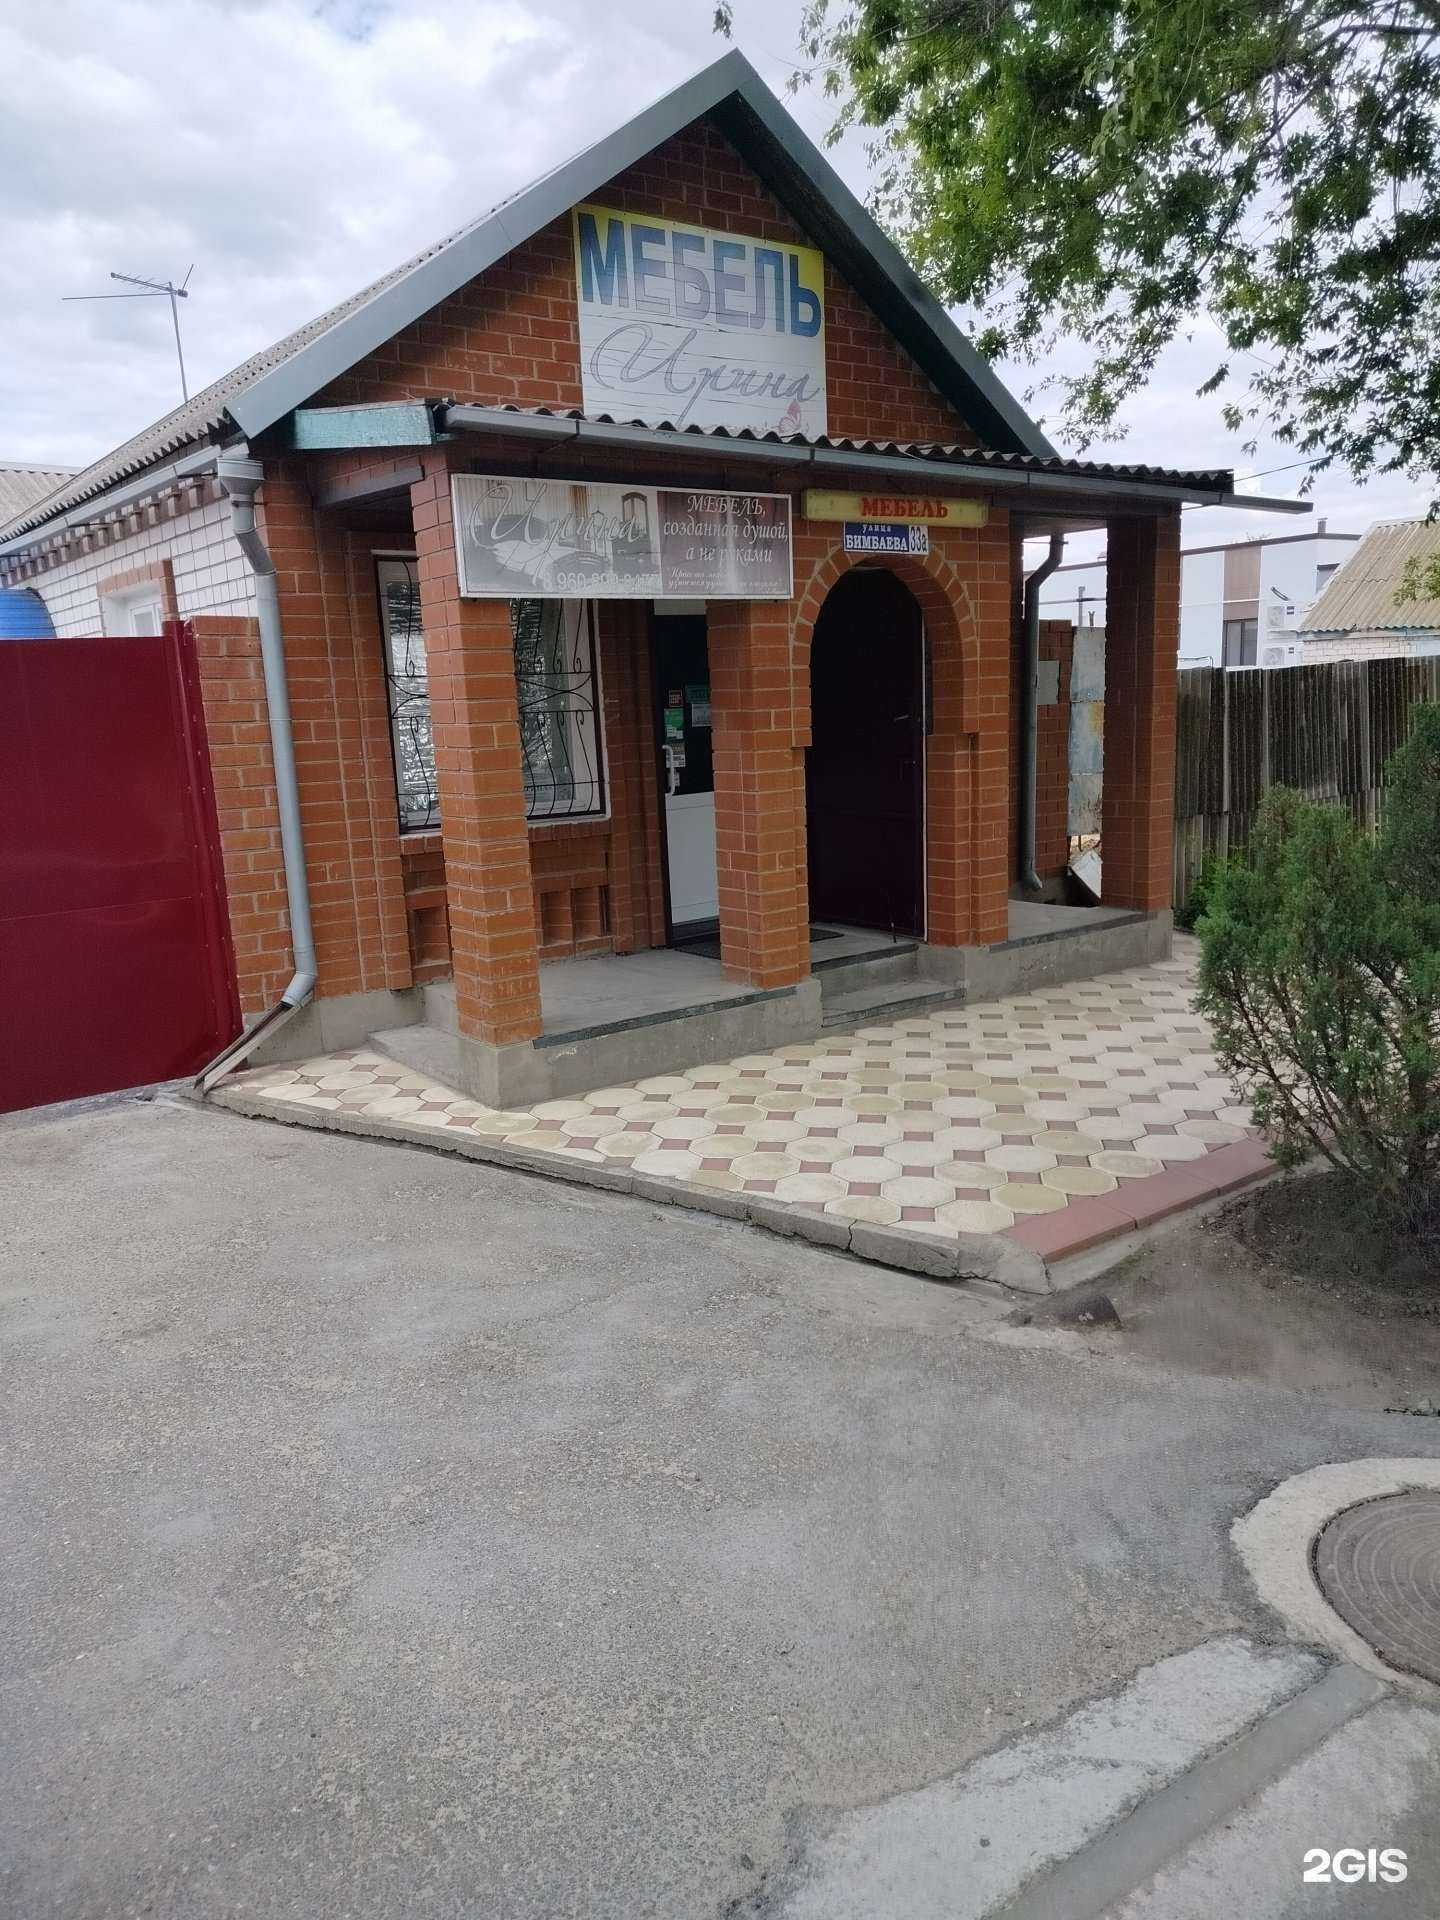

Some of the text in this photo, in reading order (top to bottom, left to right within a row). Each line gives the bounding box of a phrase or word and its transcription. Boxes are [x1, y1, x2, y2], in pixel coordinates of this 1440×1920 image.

[577, 212, 823, 338] МЕБЕЛЬ
[589, 323, 821, 425] Ирина
[686, 494, 766, 518] МЕБЕЛЬ,
[861, 498, 948, 518] МЕБЕЛЬ
[469, 482, 642, 586] Ирина
[663, 514, 789, 545] созданная душой,
[846, 535, 908, 550] БИМБАЕВА
[718, 546, 774, 568] рками
